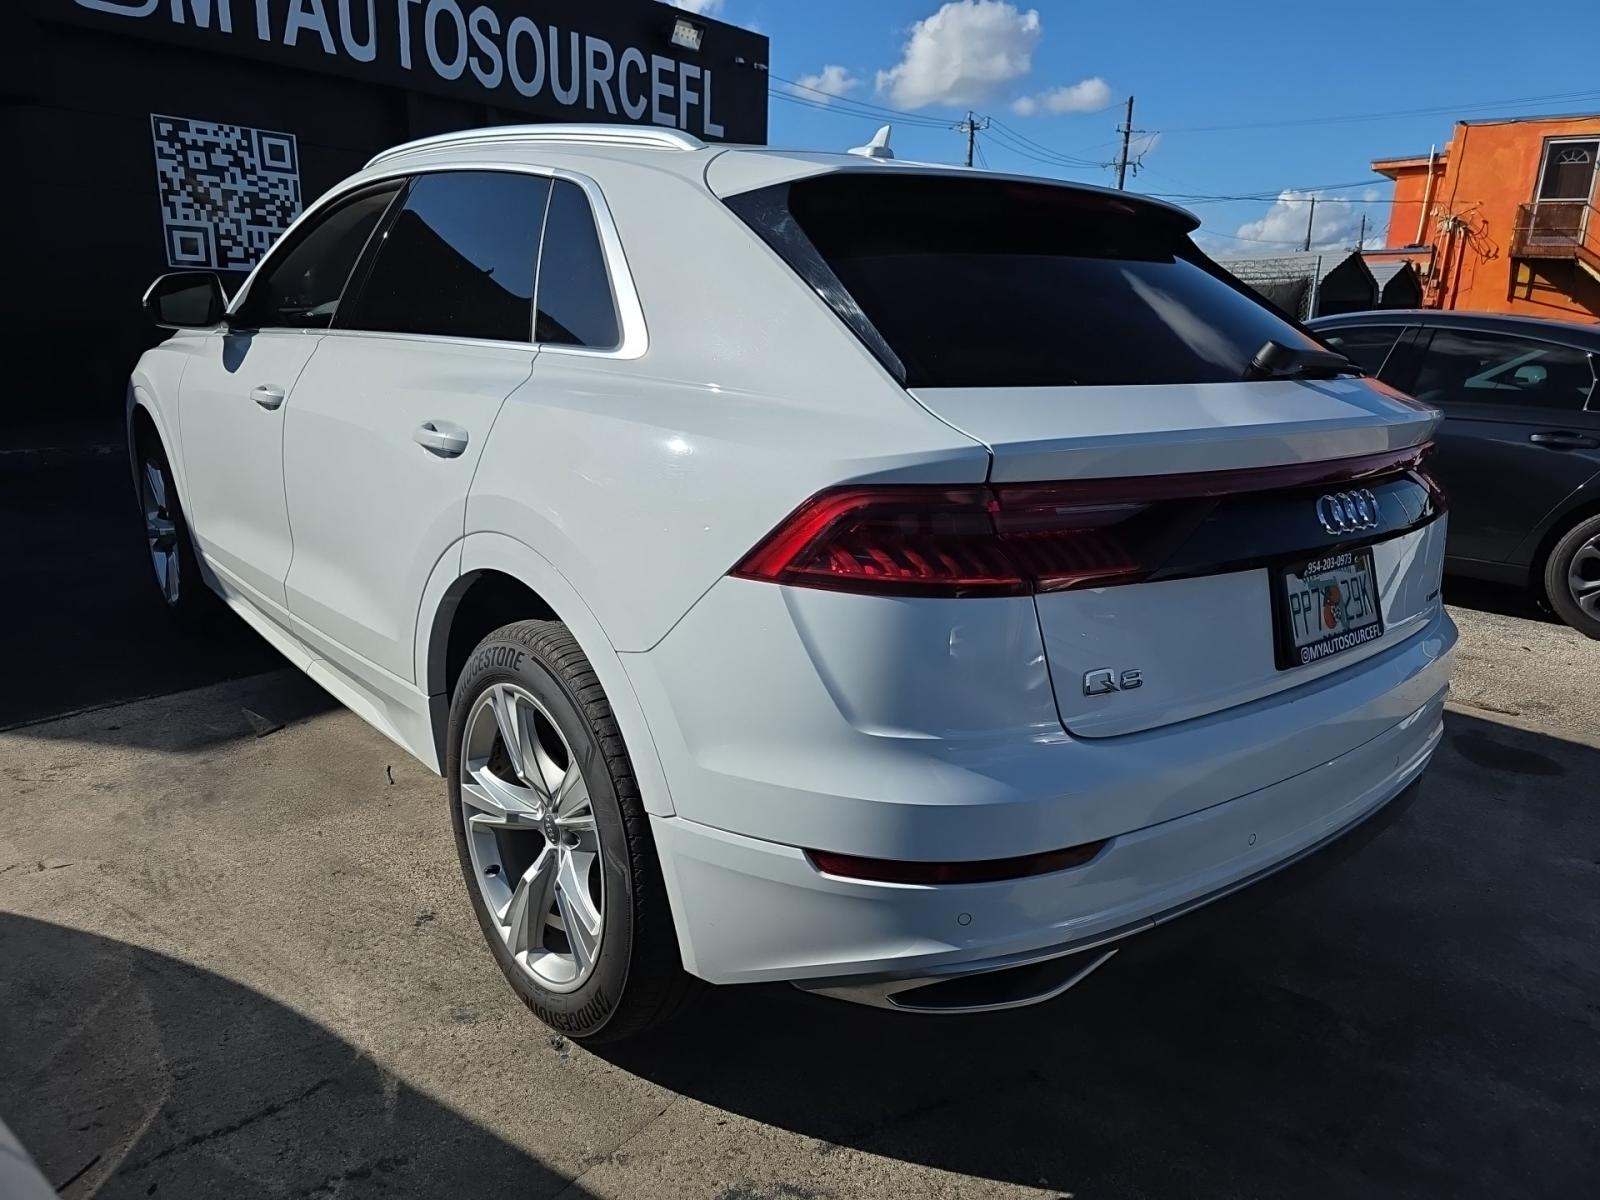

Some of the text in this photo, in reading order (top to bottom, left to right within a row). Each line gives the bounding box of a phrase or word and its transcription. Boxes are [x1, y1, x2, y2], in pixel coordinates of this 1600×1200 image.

[74, 0, 724, 138] AUTOSOURCEFL
[1308, 553, 1352, 575] 954-203-0973
[1300, 625, 1382, 664] @MYAUTOSOURCEFL
[1082, 667, 1143, 697] Q8
